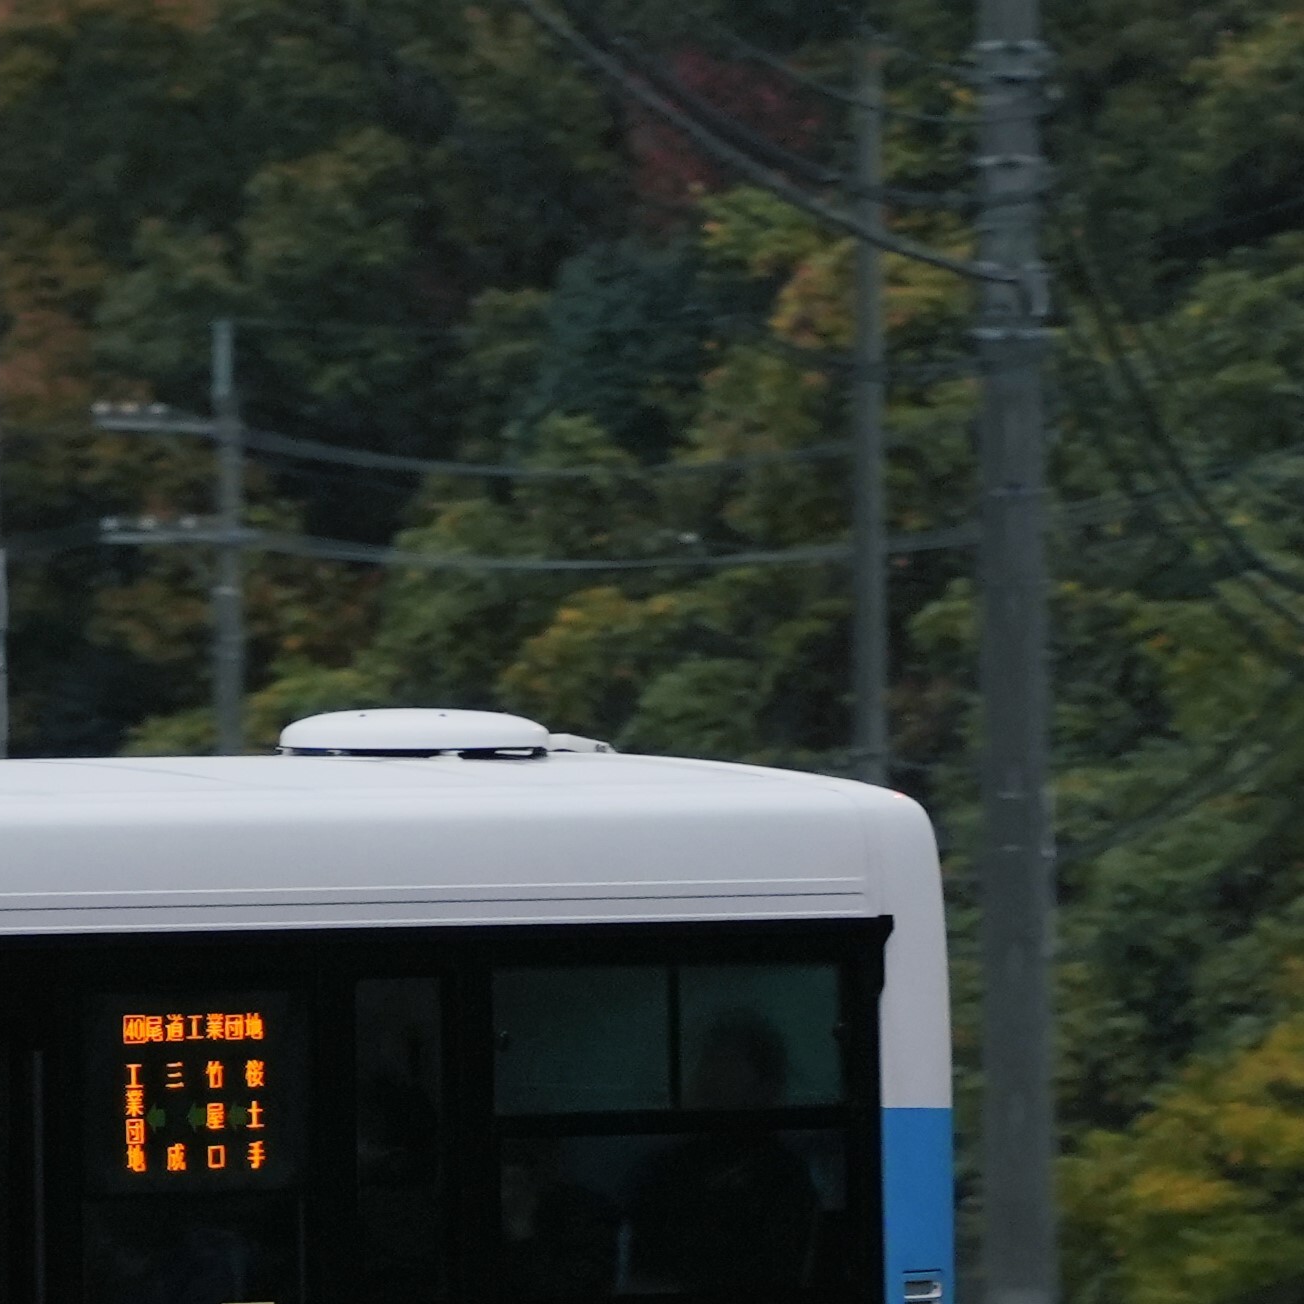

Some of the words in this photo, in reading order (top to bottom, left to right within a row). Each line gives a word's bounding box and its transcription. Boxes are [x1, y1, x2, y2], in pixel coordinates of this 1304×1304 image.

[125, 1017, 144, 1042] 40
[145, 1013, 265, 1042] 尾道工業団地
